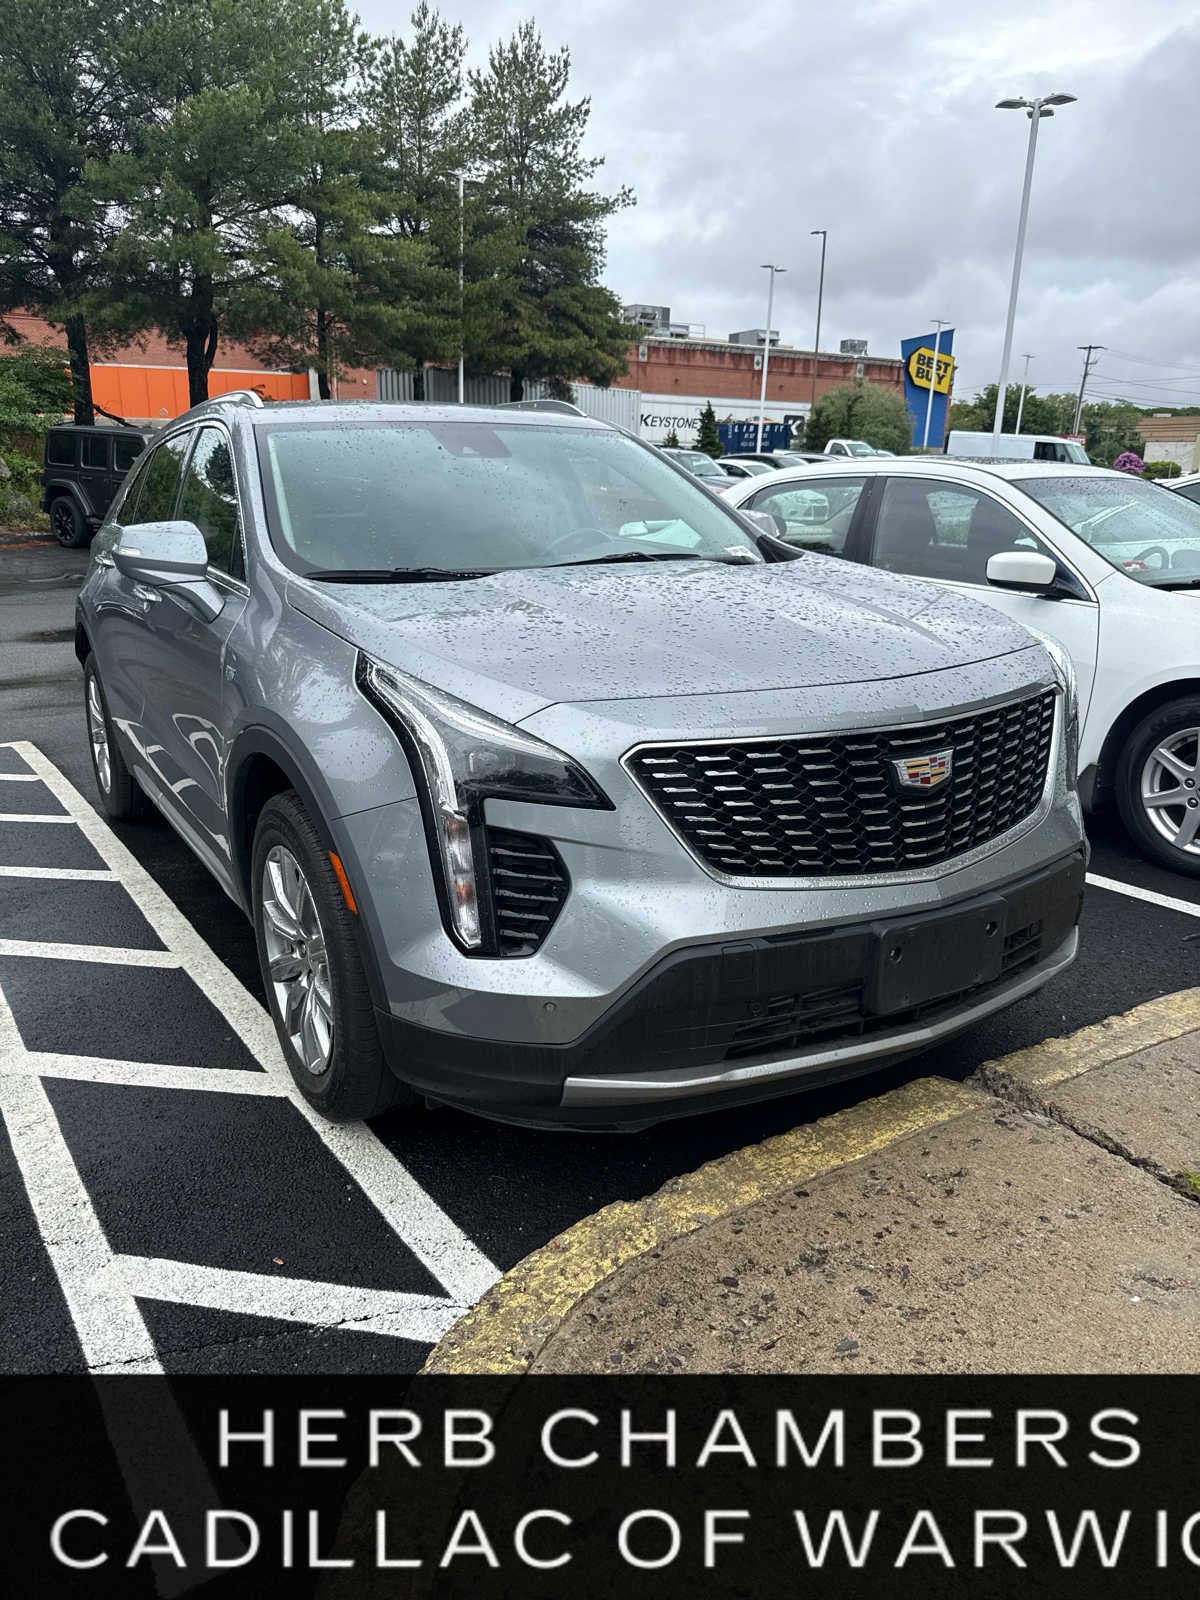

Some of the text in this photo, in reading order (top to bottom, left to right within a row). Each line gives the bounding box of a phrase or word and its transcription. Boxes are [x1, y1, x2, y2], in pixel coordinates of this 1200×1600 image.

[916, 353, 951, 374] BEST
[915, 366, 946, 385] BUY
[640, 414, 702, 429] KEYSTONE
[734, 424, 784, 433] LIBRTY
